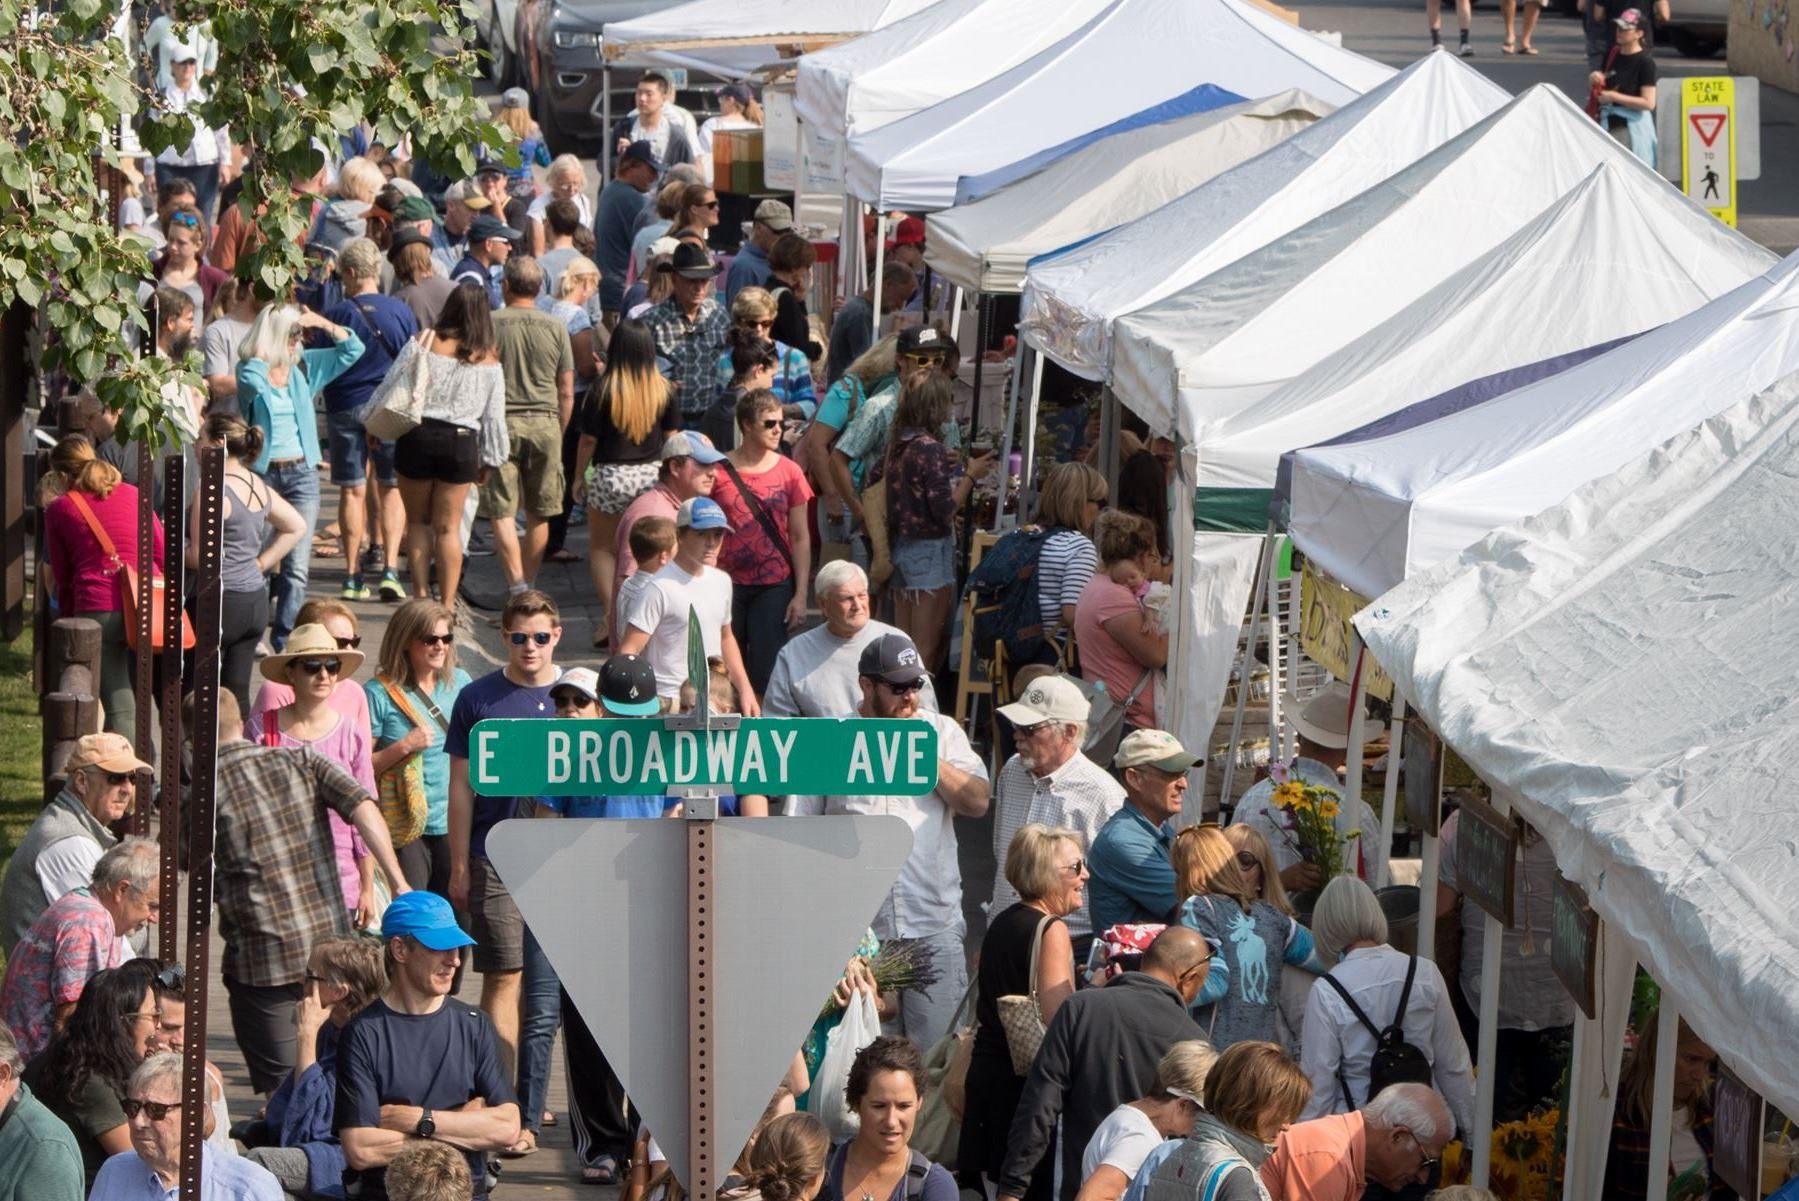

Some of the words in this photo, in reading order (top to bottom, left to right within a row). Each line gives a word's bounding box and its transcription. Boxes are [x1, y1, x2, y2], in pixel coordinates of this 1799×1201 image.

[1692, 82, 1724, 92] STATE
[1697, 94, 1719, 103] LAW
[1704, 152, 1715, 161] TO
[478, 731, 499, 784] E
[547, 730, 797, 784] BROADWAY
[846, 731, 928, 784] AVE
